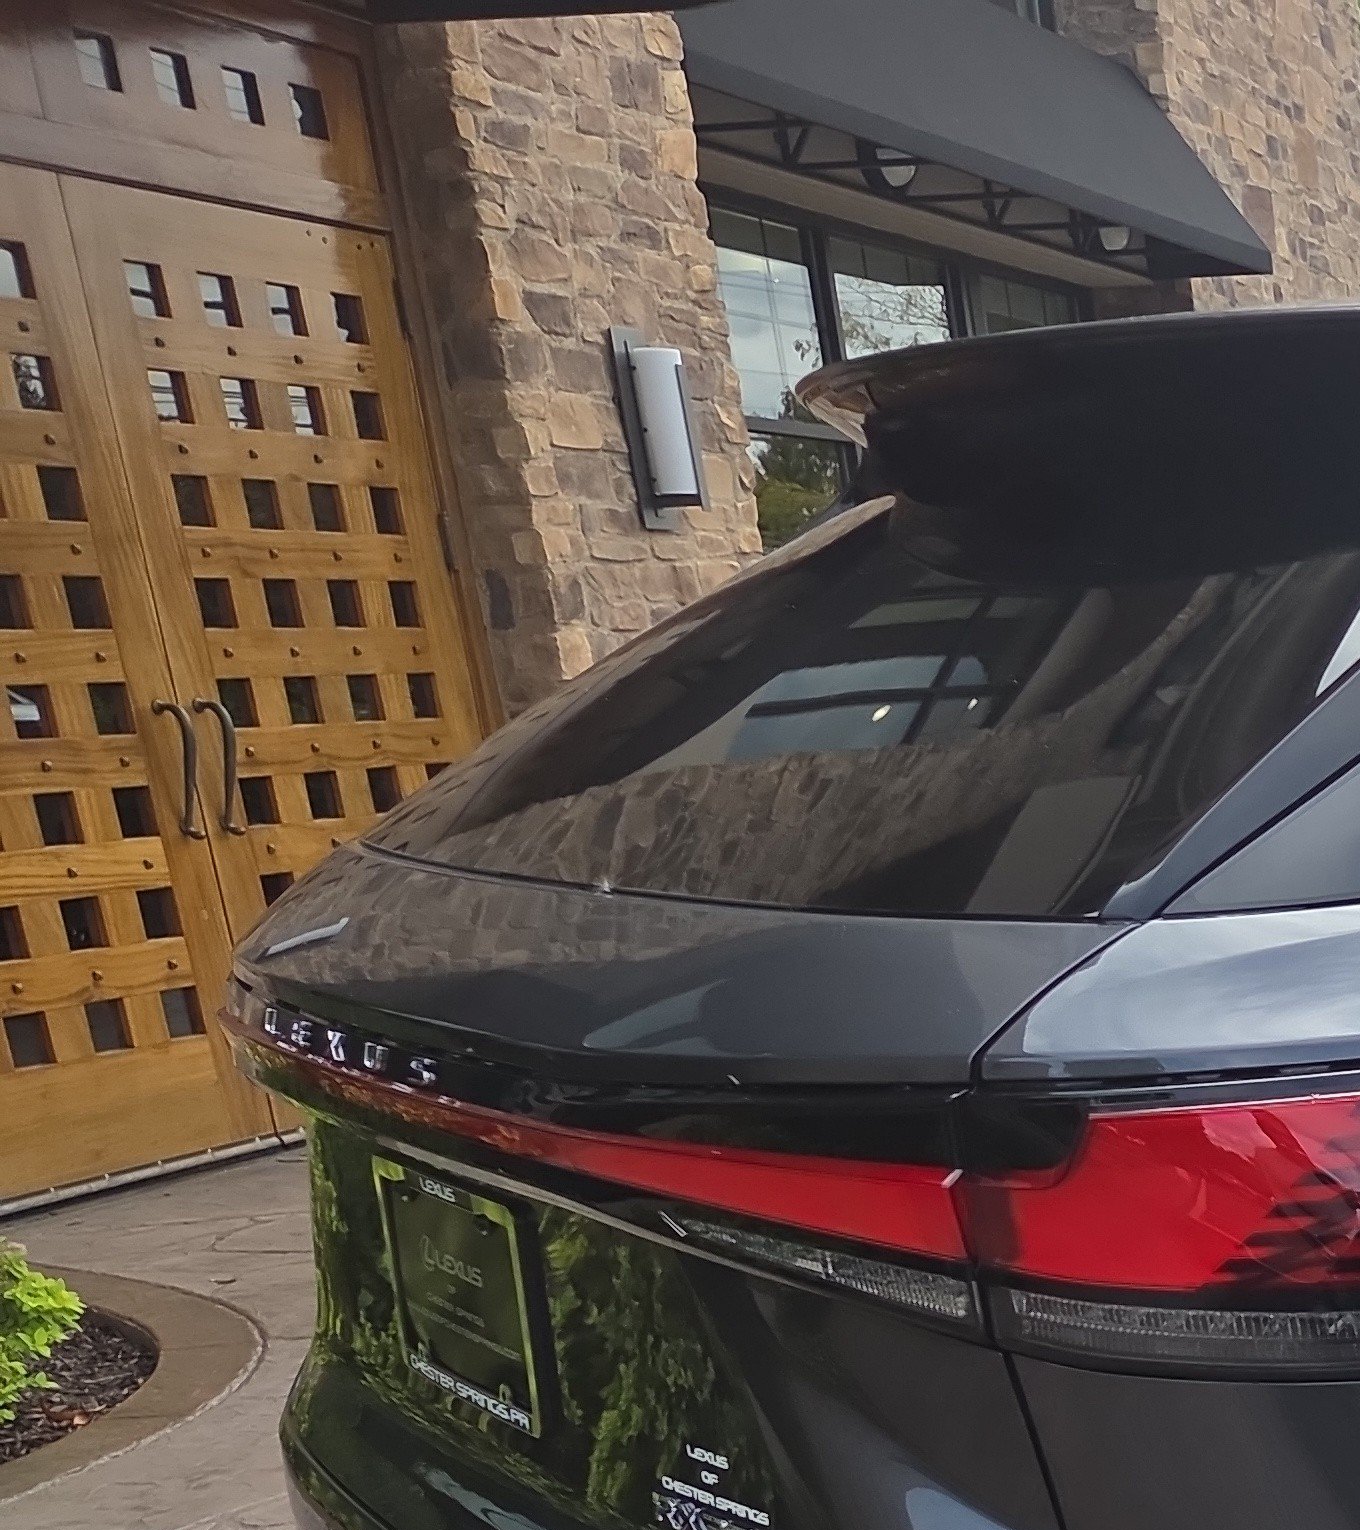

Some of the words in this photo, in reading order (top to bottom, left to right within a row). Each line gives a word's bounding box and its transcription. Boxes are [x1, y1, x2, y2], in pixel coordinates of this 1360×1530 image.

[264, 1007, 438, 1086] LEXUS
[418, 1176, 456, 1203] LEXUS
[686, 1443, 729, 1470] LEXUS
[700, 1470, 719, 1485] OF
[661, 1475, 715, 1507] CHESTER
[715, 1496, 770, 1527] SPRINGS
